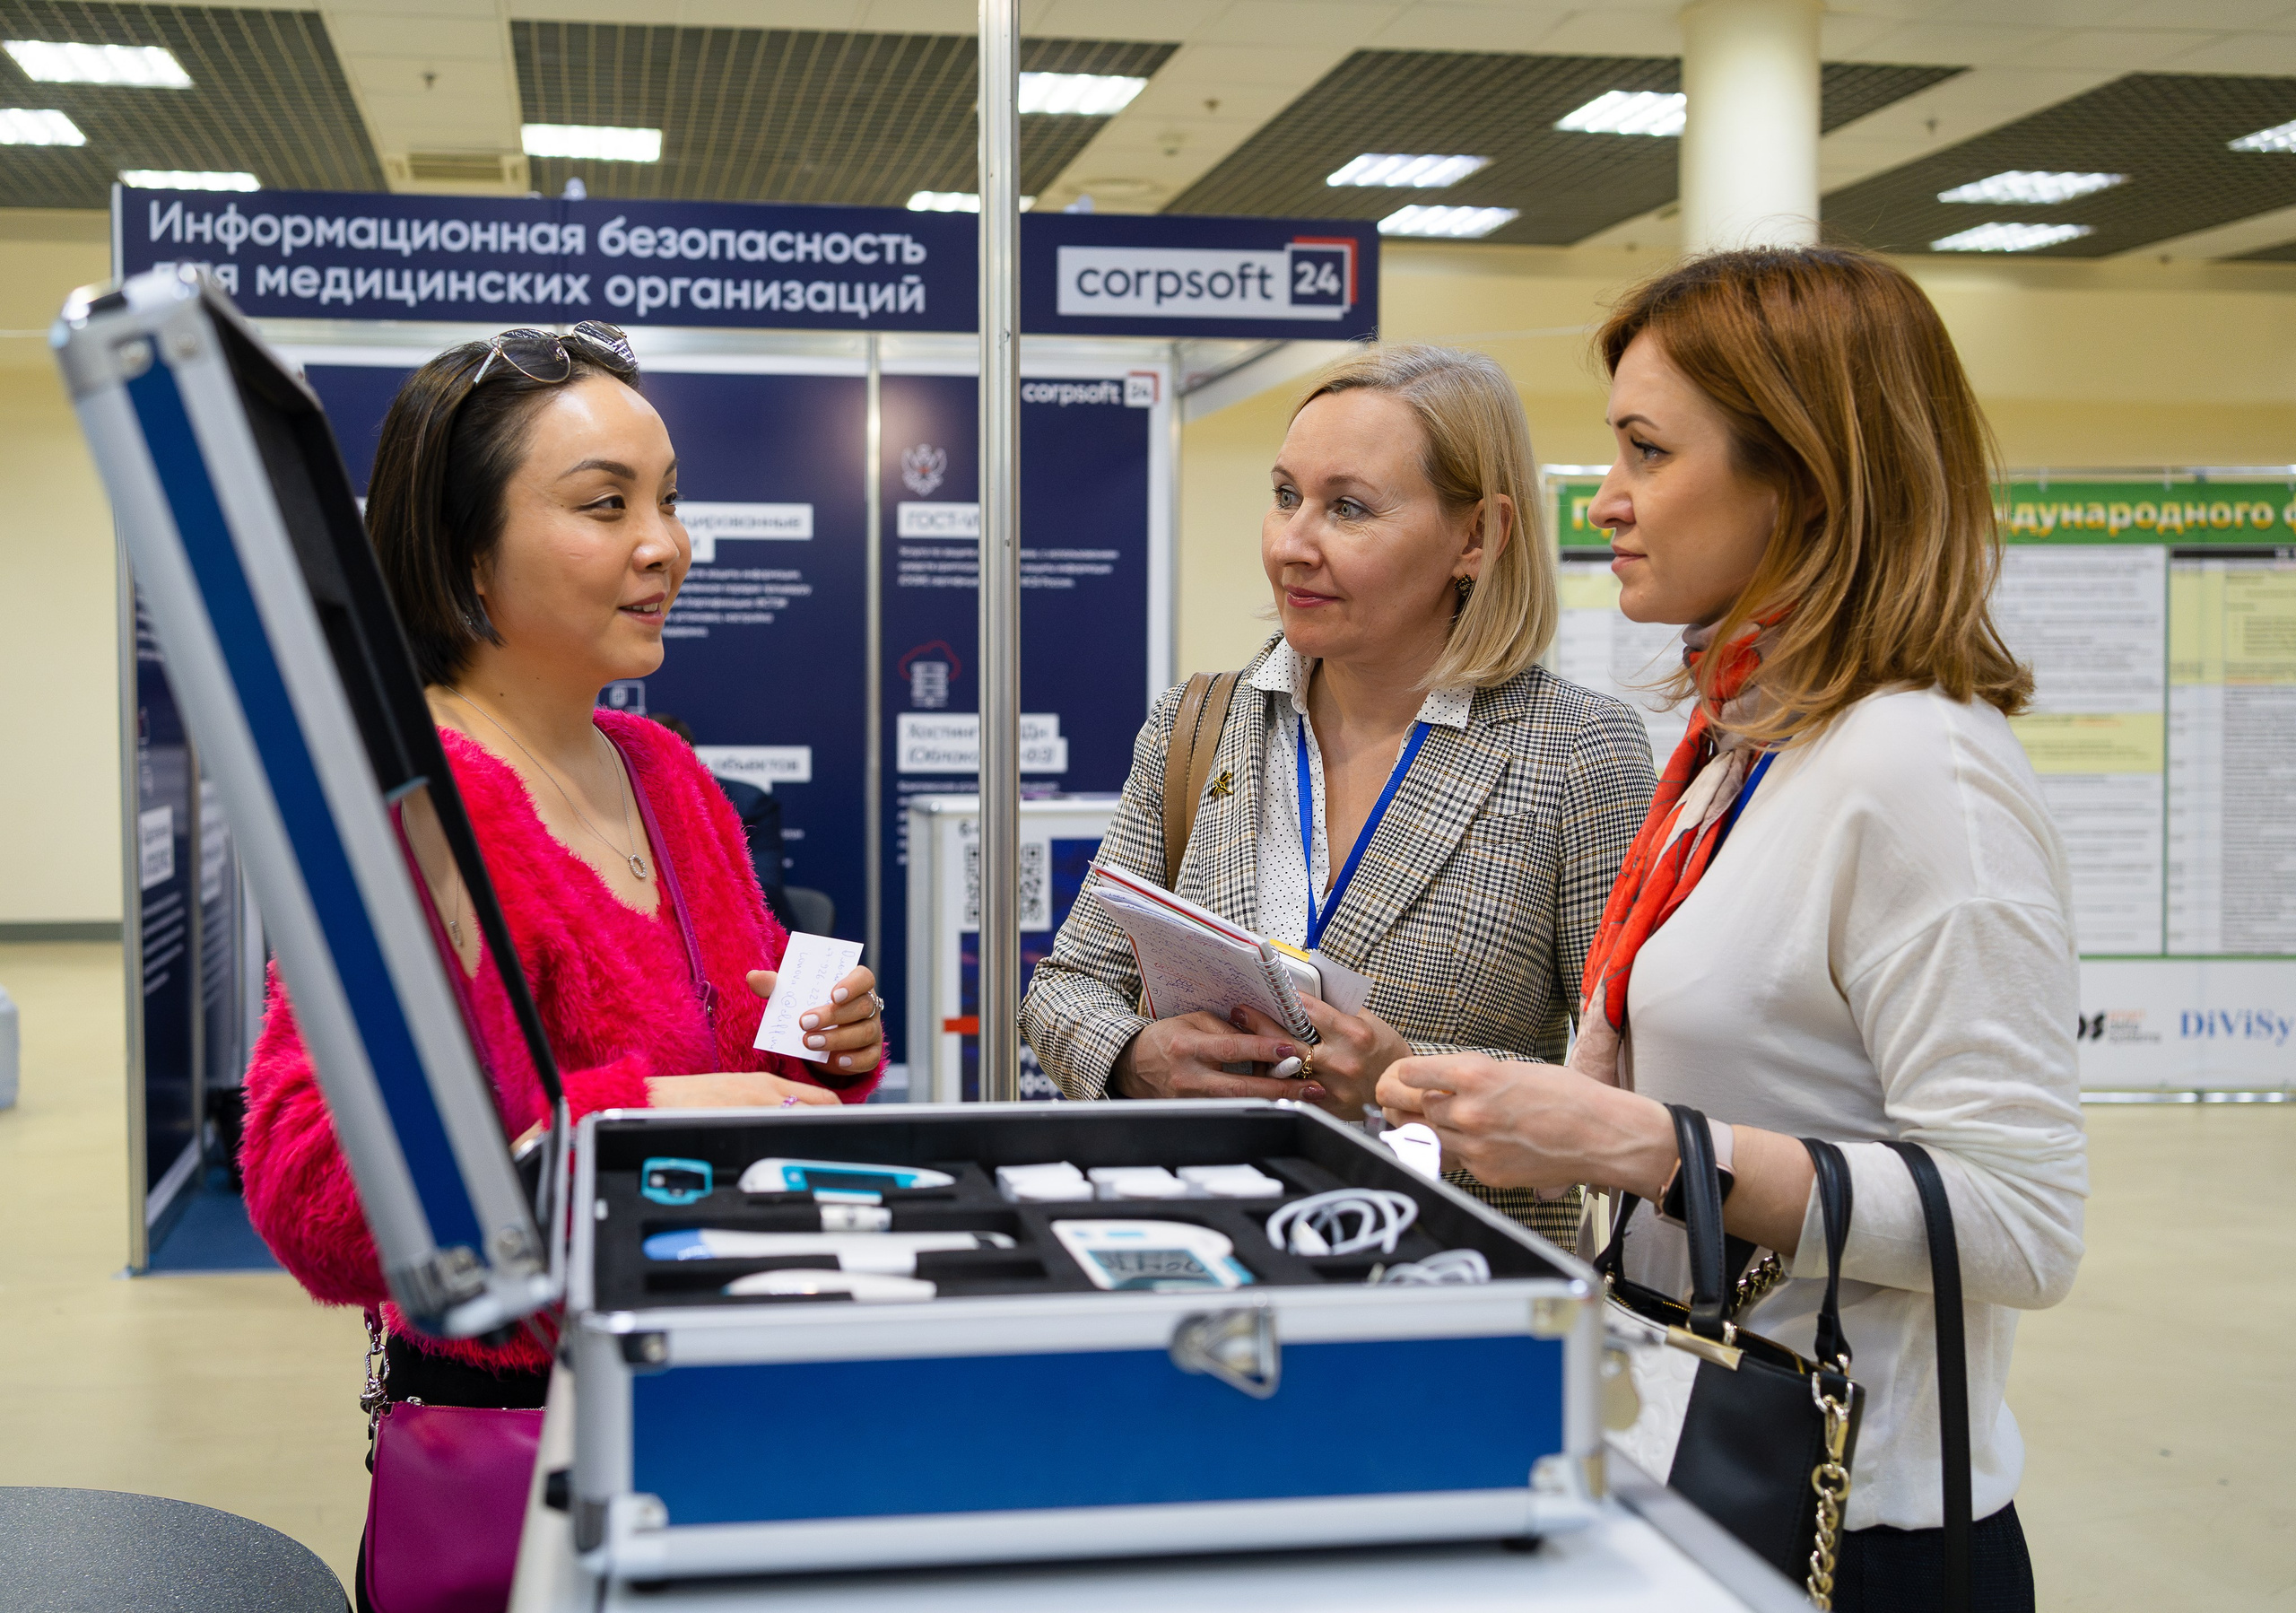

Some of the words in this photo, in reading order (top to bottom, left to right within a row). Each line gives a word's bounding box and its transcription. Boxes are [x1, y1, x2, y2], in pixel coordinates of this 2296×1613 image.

[149, 199, 585, 256] Информационная
[599, 215, 927, 266] безопасность
[256, 264, 591, 308] медицинских
[604, 273, 926, 318] организаций
[1076, 259, 1274, 305] corpsoft
[1293, 260, 1342, 297] 24
[1021, 381, 1122, 407] corpsoft
